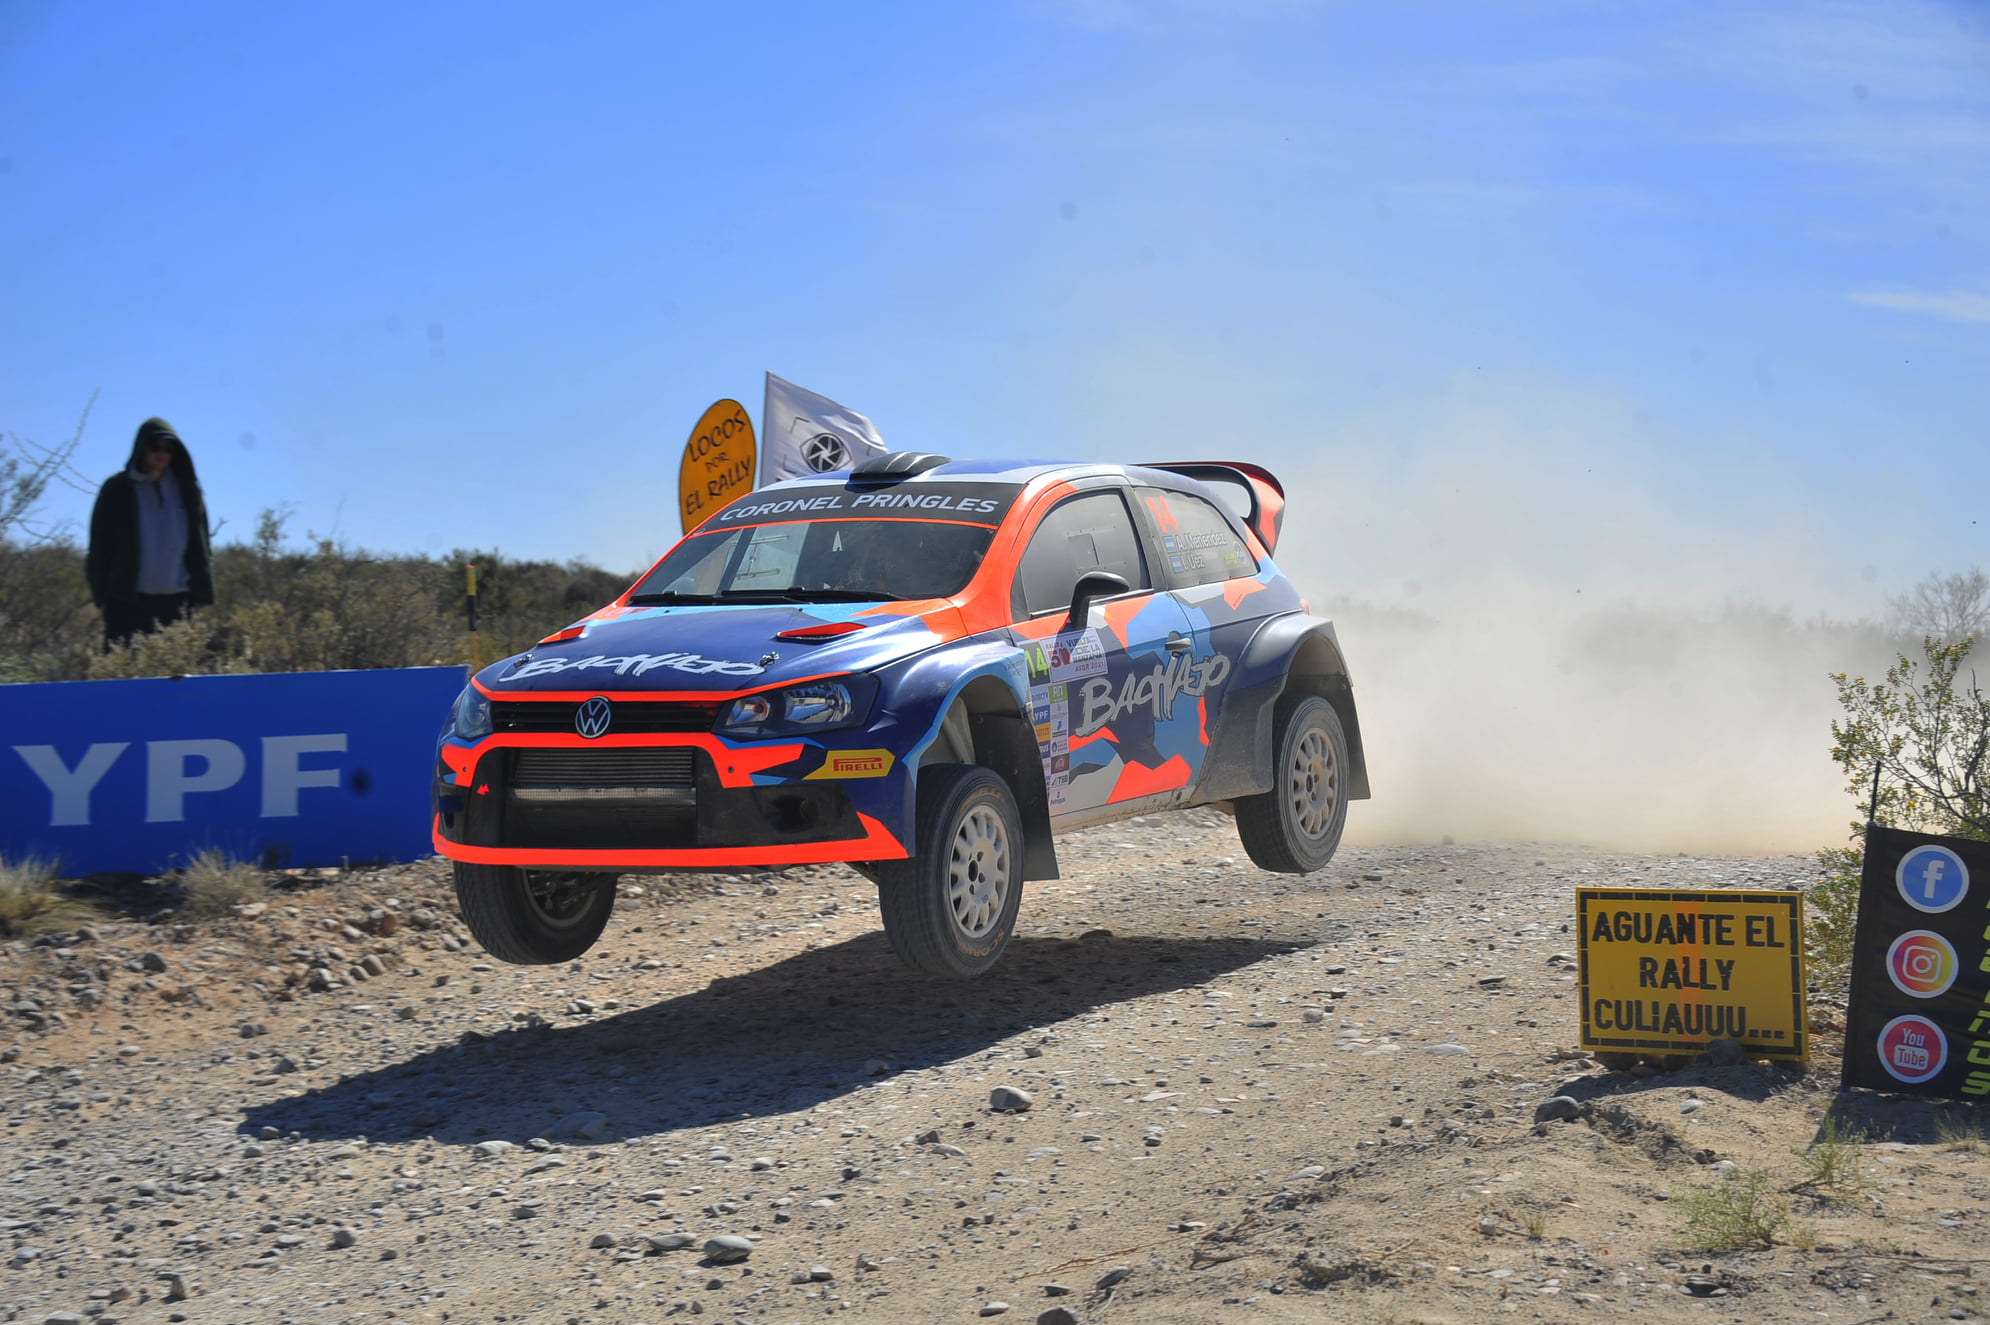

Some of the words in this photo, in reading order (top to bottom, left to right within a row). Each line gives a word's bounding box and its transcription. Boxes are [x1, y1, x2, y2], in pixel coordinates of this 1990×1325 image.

[688, 410, 746, 462] LOCOS
[705, 452, 729, 472] POR
[686, 490, 704, 515] EL
[707, 456, 750, 499] RALLY
[720, 496, 843, 521] CORONEL
[851, 494, 999, 513] PRINGLES
[1147, 495, 1178, 534] 14
[1066, 636, 1091, 648] VUELTA
[1025, 647, 1049, 679] 14
[1034, 710, 1049, 720] YPF
[10, 733, 348, 826] YPF
[833, 756, 883, 772] PIRELLI
[1592, 911, 1735, 945] AGUANTE
[1746, 915, 1785, 948] EL
[1639, 956, 1735, 991] RALLY
[1594, 998, 1785, 1039] CULIAUUU...
[1902, 1028, 1925, 1047] You
[1898, 1048, 1926, 1067] Tube
